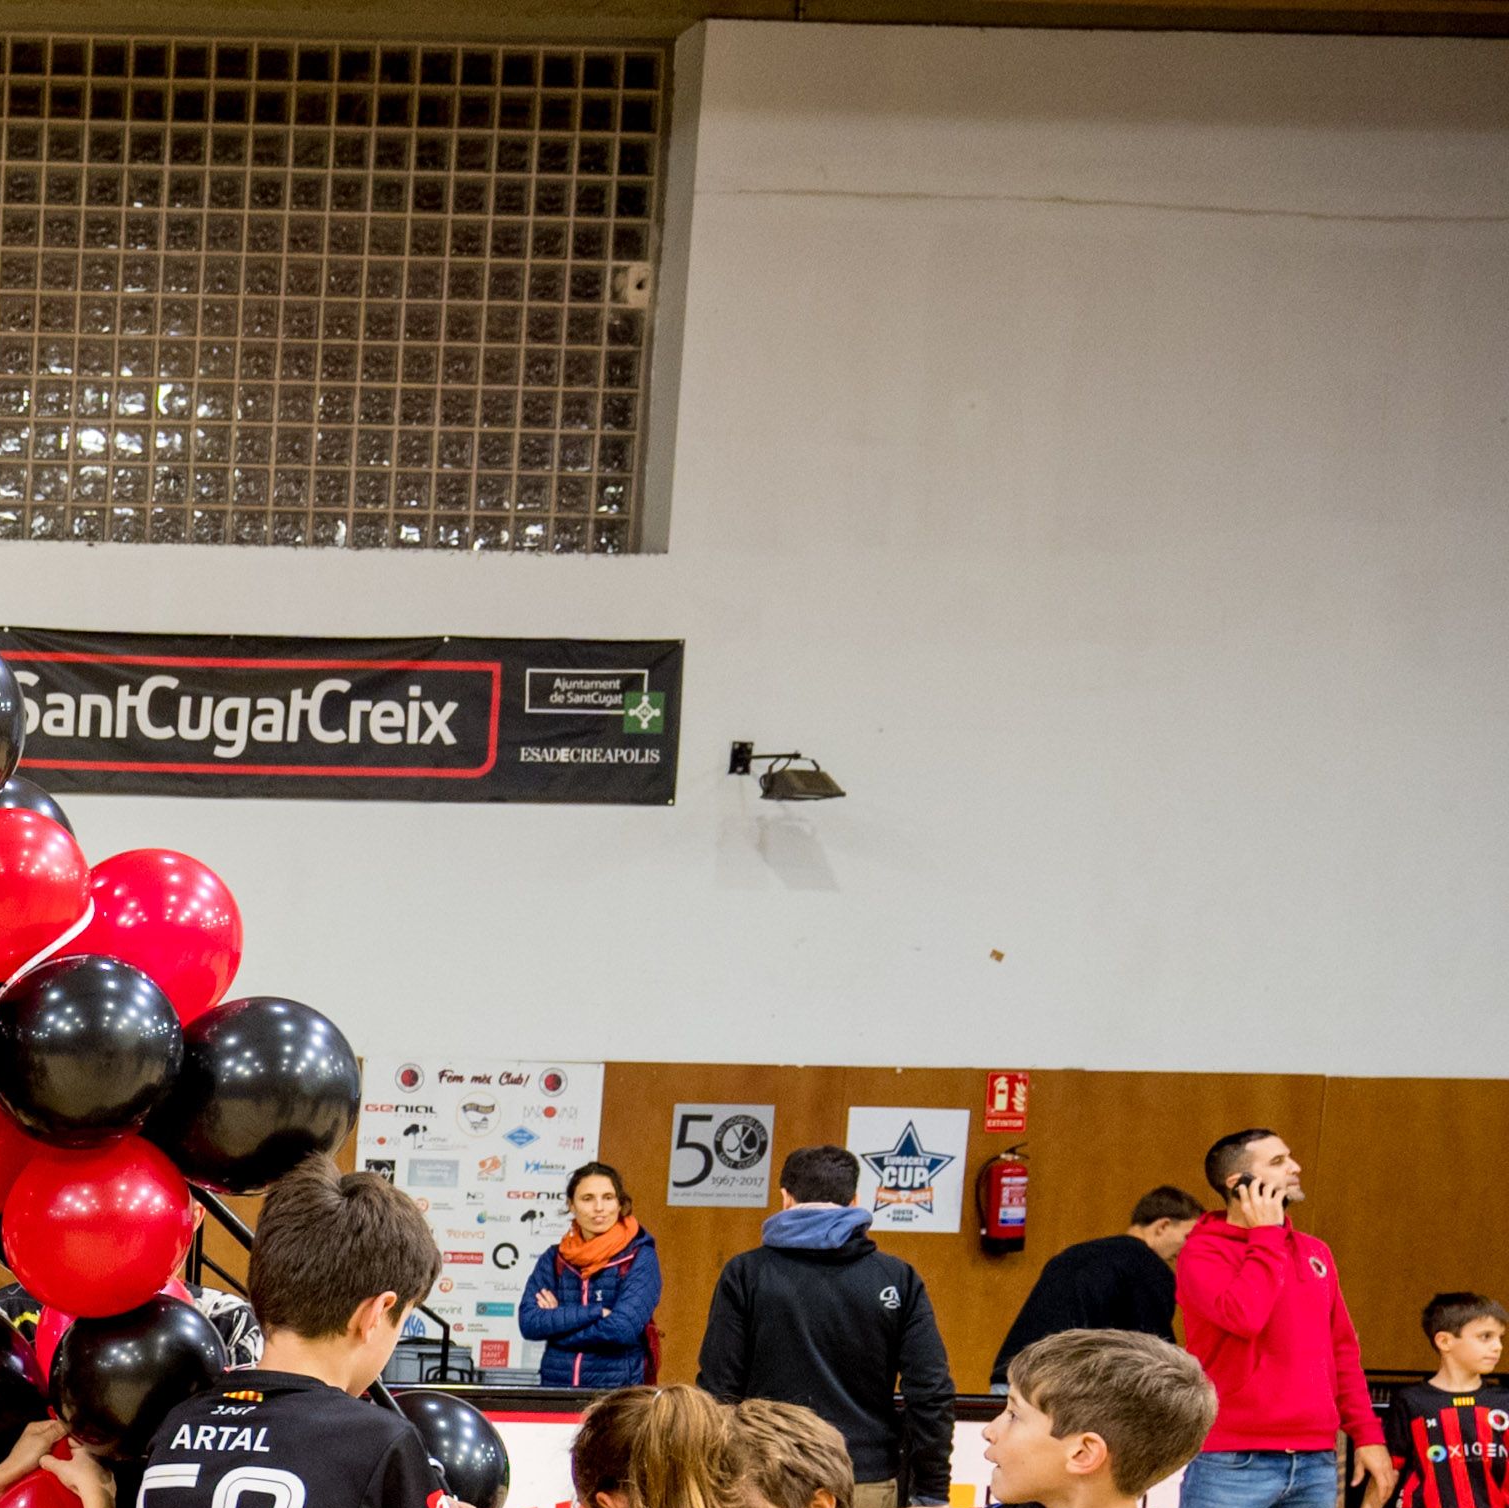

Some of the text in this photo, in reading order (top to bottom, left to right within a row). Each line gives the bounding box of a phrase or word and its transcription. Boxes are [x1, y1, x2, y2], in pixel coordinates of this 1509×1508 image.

[552, 677, 621, 692] Ajuntament
[519, 747, 661, 764] ESADECREAPOLIS
[987, 1118, 1023, 1128] EXTINTOR
[712, 1176, 764, 1187] 1967-2017
[882, 1166, 931, 1188] CUP
[170, 1424, 271, 1453] ARTAL
